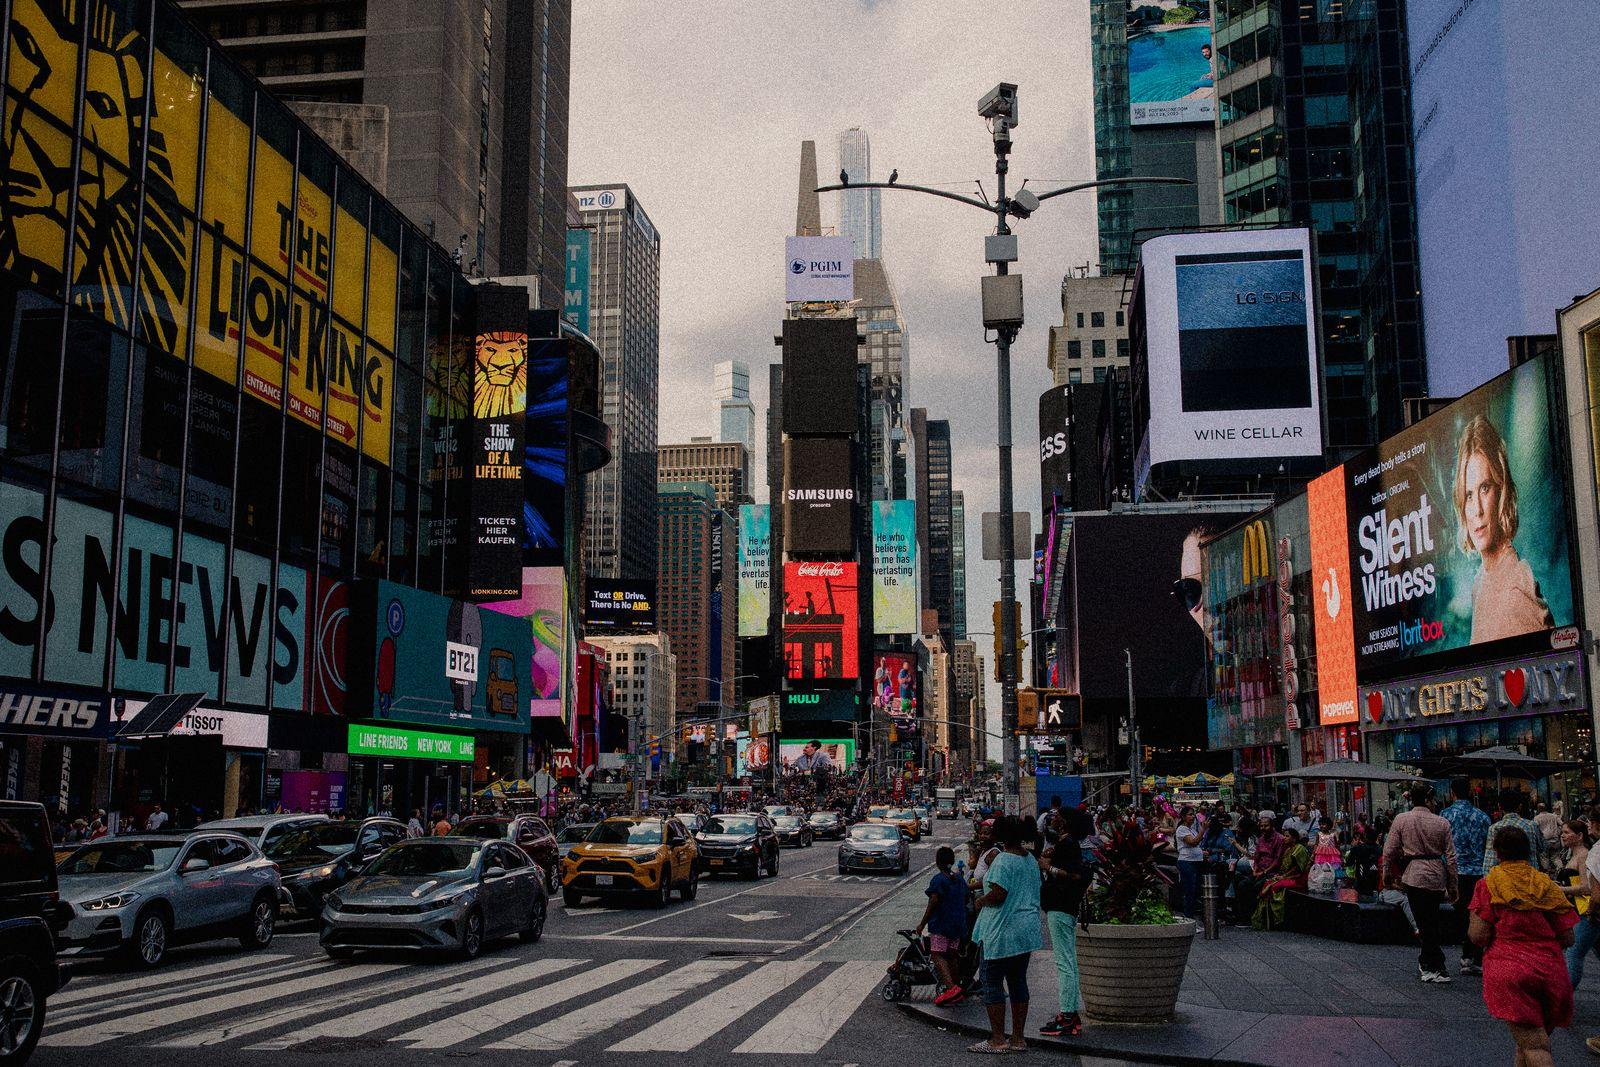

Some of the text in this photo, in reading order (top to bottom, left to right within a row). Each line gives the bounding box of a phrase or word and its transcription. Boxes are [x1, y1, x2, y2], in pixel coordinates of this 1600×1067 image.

[277, 202, 329, 280] THE
[810, 261, 842, 271] PGIM
[1236, 292, 1257, 305] LG
[209, 220, 383, 410] LION KING
[246, 373, 346, 436] ENTRANCE ON 45TH STREET
[490, 423, 510, 438] THE
[1194, 426, 1303, 441] WINE CELLAR
[484, 437, 515, 451] SHOW
[488, 451, 510, 465] OF A
[1354, 442, 1426, 486] Every dead body tells a story
[475, 465, 522, 480] LIFETIME
[788, 488, 854, 500] SAMSUNG
[1389, 479, 1410, 497] ORIGINAL
[478, 517, 516, 525] TICKETS
[486, 527, 508, 535] HIER
[877, 532, 905, 542] He who
[1358, 493, 1434, 574] Silent
[478, 536, 516, 545] KAUFEN
[748, 536, 758, 545] He
[875, 543, 907, 553] believes
[744, 558, 751, 567] in
[753, 559, 765, 567] me
[882, 556, 894, 564] me
[896, 554, 910, 564] has
[755, 579, 770, 589] life.
[884, 577, 899, 586] life.
[1361, 563, 1436, 612] Witness
[594, 590, 646, 600] Text OR Drive.
[78, 534, 299, 684] NEWS
[590, 600, 612, 608] There
[621, 601, 632, 609] No
[632, 601, 651, 610] AND.
[1369, 625, 1399, 641] NEW SEASON
[1403, 616, 1443, 645] britbox
[1361, 637, 1400, 656] NOW STREAMING
[450, 649, 475, 674] BT21
[788, 693, 820, 704] HULU
[1418, 676, 1488, 717] GIFTS
[0, 691, 102, 729] HERS
[185, 714, 223, 731] TISSOT
[359, 732, 474, 756] LINE FRIENDS NEW YORK LINE
